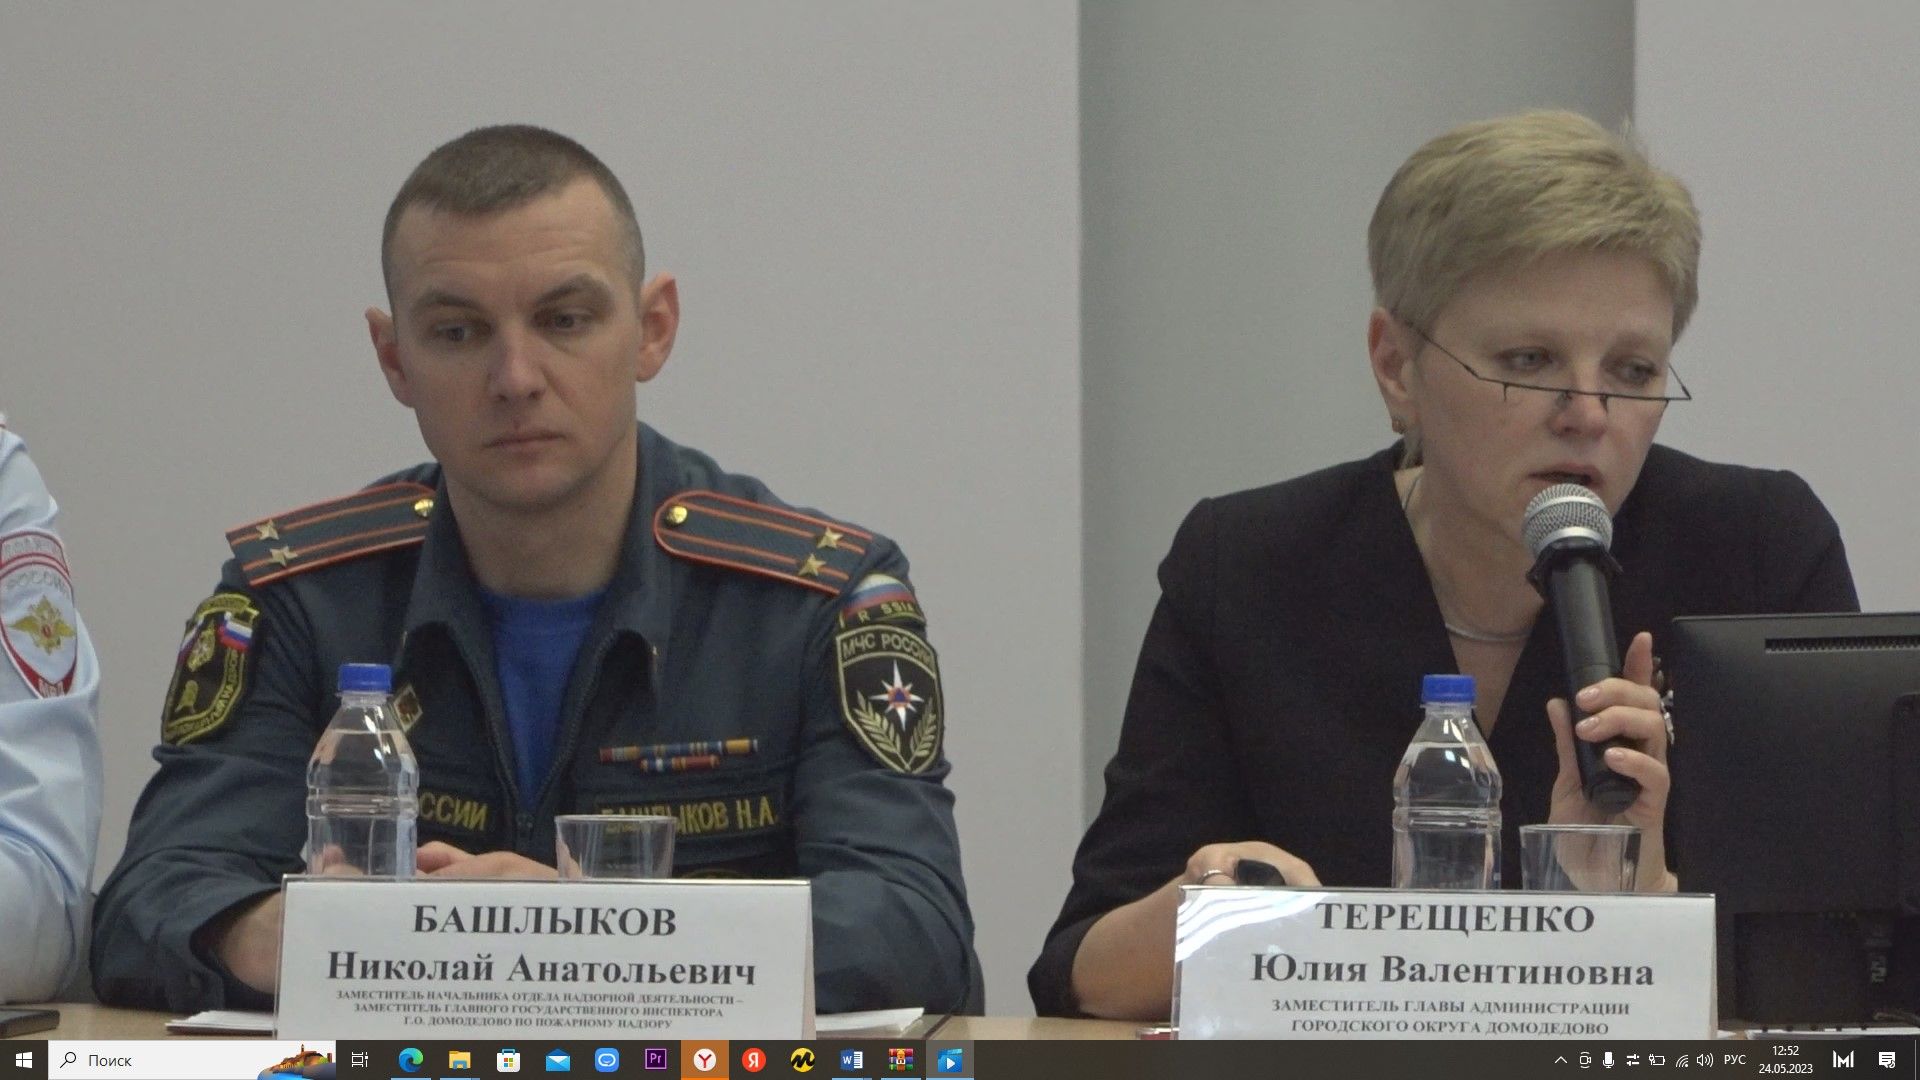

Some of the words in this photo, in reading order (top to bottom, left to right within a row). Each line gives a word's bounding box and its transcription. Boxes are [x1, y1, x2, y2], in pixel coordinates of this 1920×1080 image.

[858, 602, 914, 622] RSSIA
[842, 633, 875, 659] МЧС
[419, 792, 488, 831] ССИИ
[413, 904, 676, 936] БАШЛЫКОВ
[1315, 902, 1595, 937] ТЕРЕЩЕНКО
[327, 950, 493, 981] Николай
[506, 953, 755, 986] Анатольевич
[1251, 952, 1367, 982] Юлия
[1380, 955, 1654, 986] Валентиновна
[336, 990, 424, 1000] ЗАМЕСТИТЕЛЬ
[427, 991, 508, 1001] НАЧАЛЬНИКА
[512, 992, 559, 1002] ОТДЕЛА
[563, 992, 635, 1003] НАДЗОРНОЙ
[639, 994, 734, 1005] ДЕЯТЕЛЬНОСТИ
[1272, 999, 1399, 1012] ЗАМЕСТИТЕЛЬ
[1404, 1000, 1465, 1012] ГЛАВЫ
[1471, 1001, 1630, 1015] АДМИНИСТРАЦИИ
[354, 1003, 441, 1012] ЗАМЕСТИТЕЛЬ
[444, 1004, 508, 1014] ГЛАВНОГО
[511, 1005, 639, 1016] ГОСУДАРСТВЕННОГО
[642, 1007, 724, 1017] ИНСПЕКТОРА
[403, 1017, 425, 1025] Г.О.
[428, 1017, 512, 1027] ДОМОДЕДОВО
[515, 1018, 532, 1027] ПО
[535, 1018, 614, 1028] ПОЖАРНОМУ
[618, 1019, 673, 1029] НАДЗОРУ
[1291, 1019, 1408, 1033] ГОРОДСКОГО
[1413, 1020, 1481, 1033] ОКРУГА
[1485, 1021, 1609, 1035] ДОМОДЕДОВО
